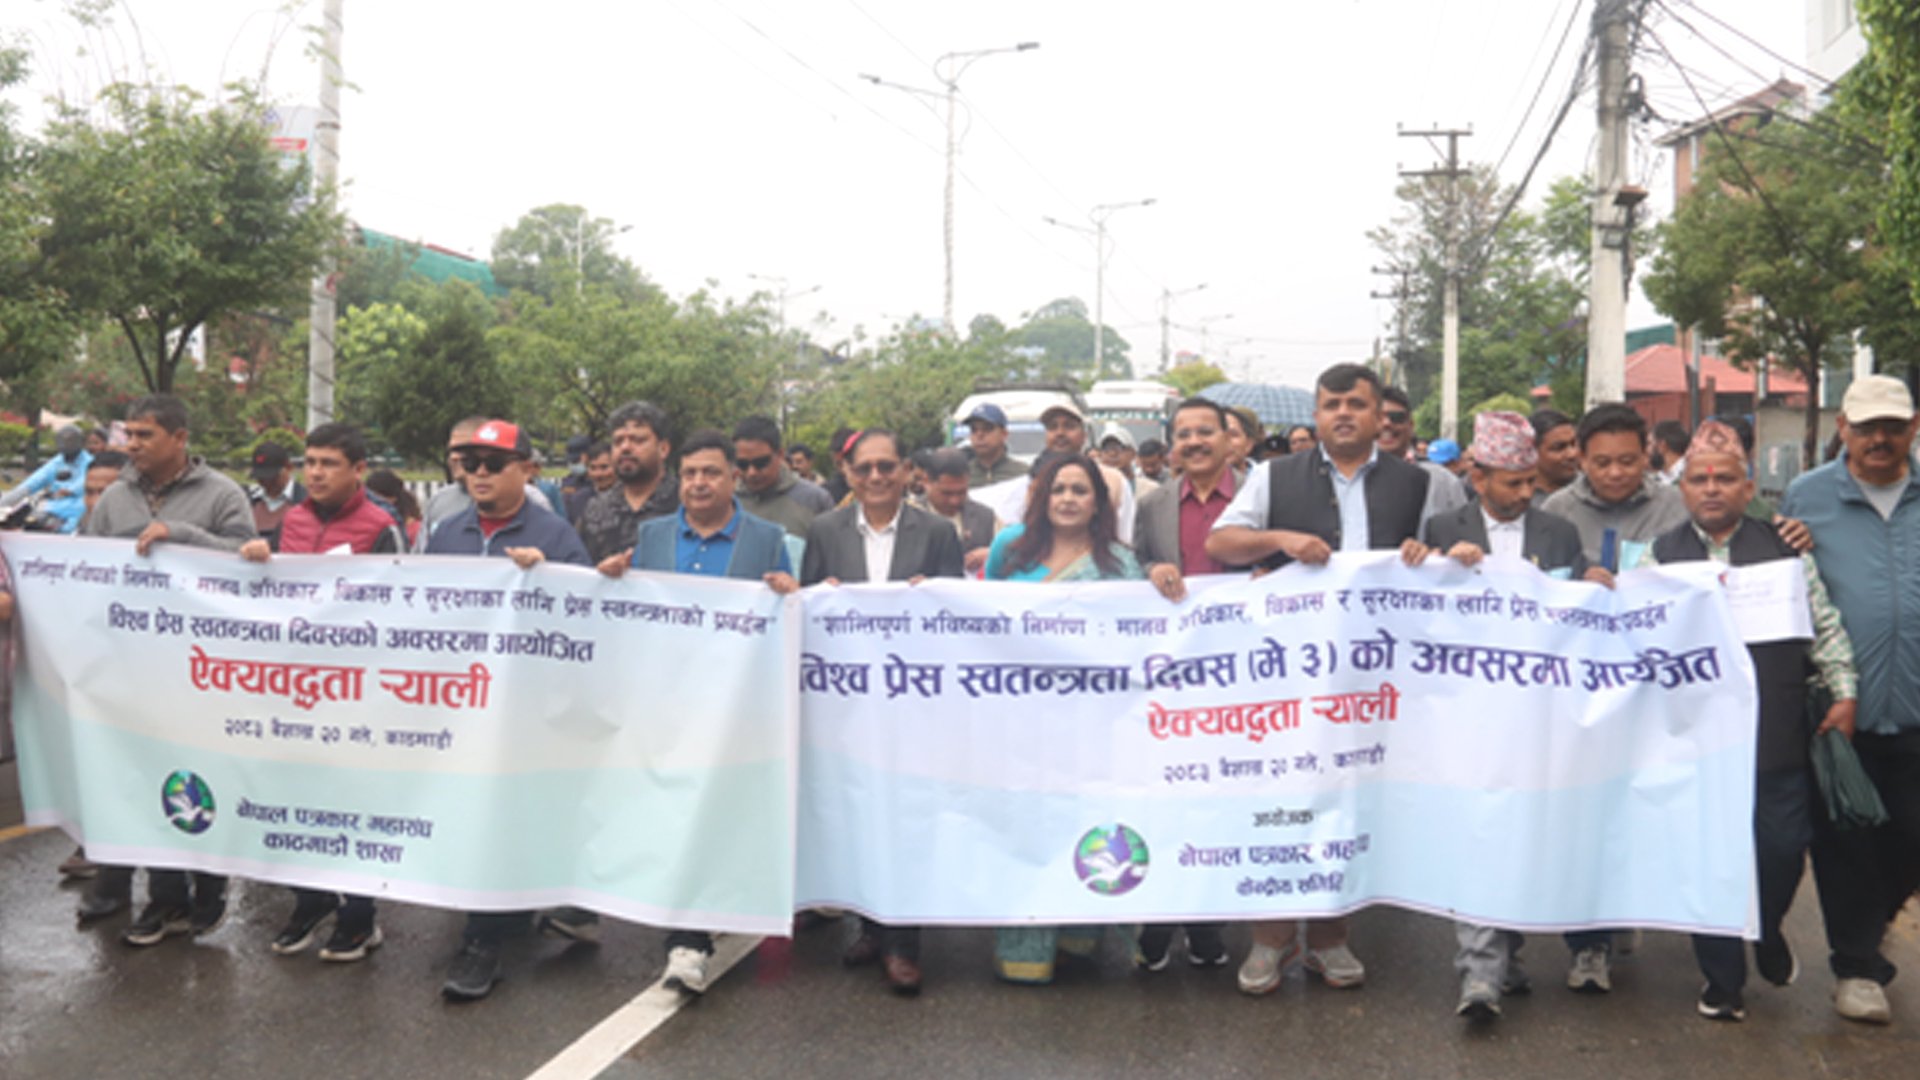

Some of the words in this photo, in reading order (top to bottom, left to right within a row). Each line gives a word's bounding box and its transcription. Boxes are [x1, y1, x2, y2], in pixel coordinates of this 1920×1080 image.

[402, 586, 416, 606] र
[921, 609, 1012, 635] भविष्यको
[1021, 610, 1087, 636] निर्माण
[1116, 616, 1167, 637] मानव
[1265, 592, 1325, 617] विकास
[1336, 589, 1352, 611] र
[1455, 589, 1503, 616] लागि
[1510, 594, 1539, 620] प्रेस
[108, 601, 149, 632] विश्व
[155, 606, 184, 635] प्रेस
[190, 615, 281, 642] स्वतन्त्रता
[288, 615, 377, 647] दिवसको
[386, 628, 490, 652] अवसरमा
[494, 628, 594, 662] आयोजित
[798, 652, 871, 697] विश्व
[883, 652, 945, 699] प्रेस
[957, 663, 1131, 697] स्वतन्त्रता
[1144, 652, 1236, 691] दिवस
[1350, 627, 1398, 671] को
[1410, 639, 1571, 689] अवसरमा
[236, 797, 288, 824] नेपाल
[294, 806, 362, 832] पत्रकार
[367, 813, 434, 839] महासंघ
[355, 838, 404, 864] शाखा
[1178, 842, 1242, 868] नेपाल
[1248, 843, 1315, 867] पत्रकार
